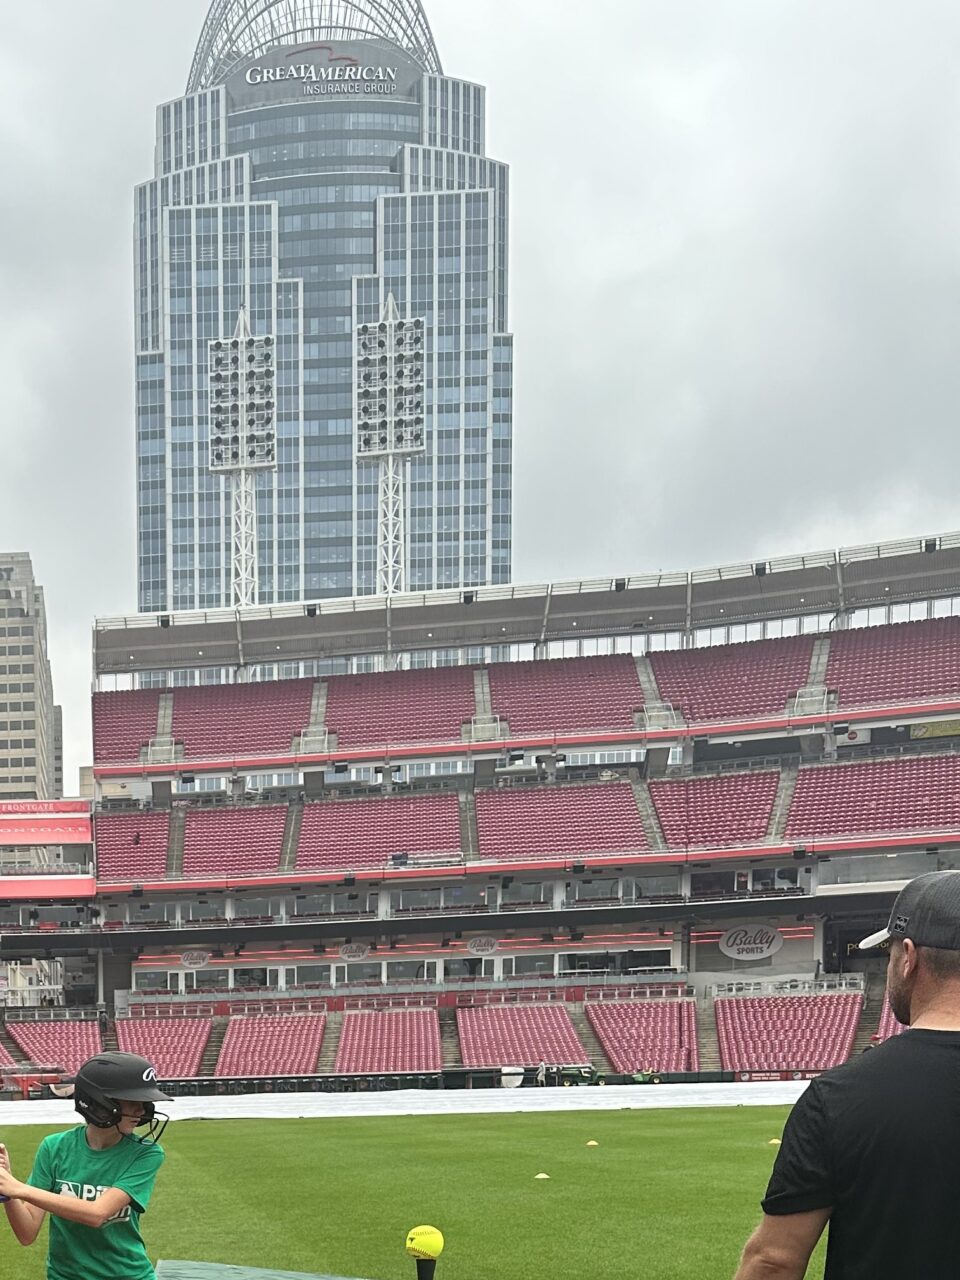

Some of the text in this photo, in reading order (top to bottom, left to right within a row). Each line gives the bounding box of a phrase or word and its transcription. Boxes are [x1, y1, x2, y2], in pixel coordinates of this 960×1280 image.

[303, 82, 397, 95] INSURANCE GROUP
[1, 803, 54, 812] FRONTGATE
[726, 928, 777, 949] Bally
[736, 946, 765, 955] SPORTS
